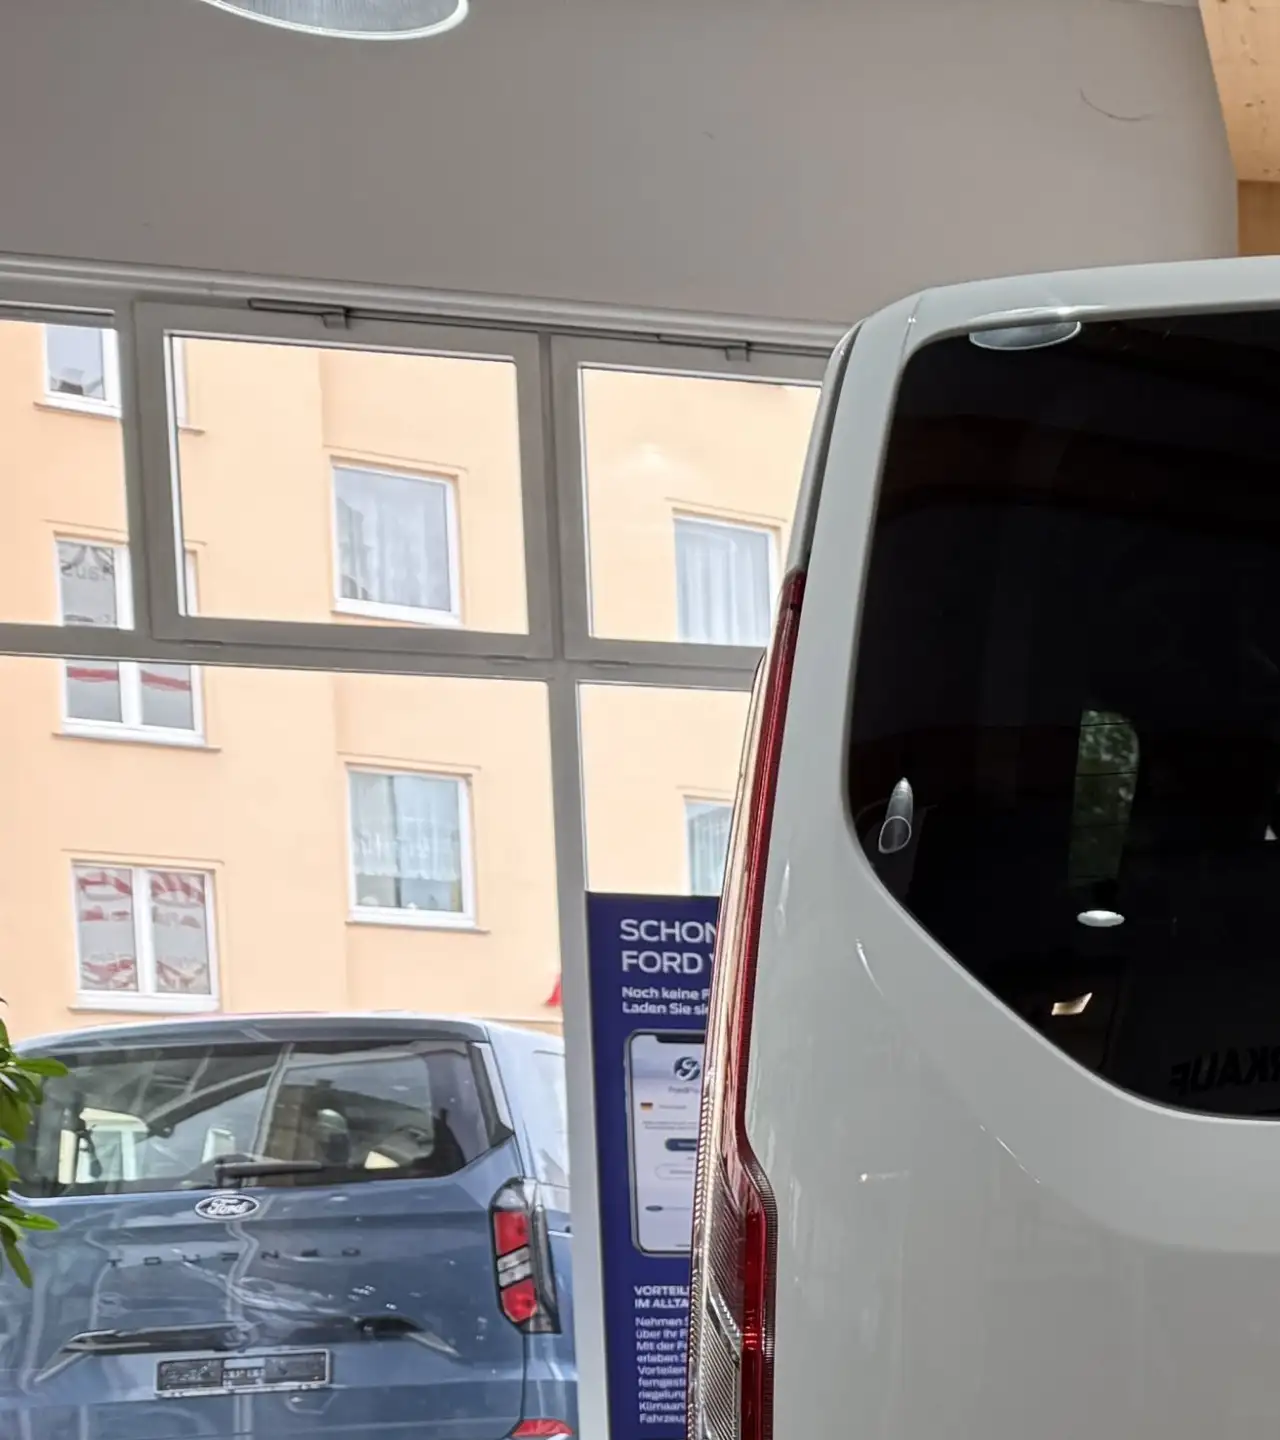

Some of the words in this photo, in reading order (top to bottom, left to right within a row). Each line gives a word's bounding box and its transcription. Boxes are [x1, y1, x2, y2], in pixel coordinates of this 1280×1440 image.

[621, 950, 704, 975] FORD
[622, 986, 660, 999] Noch
[661, 987, 700, 1000] keine
[622, 1001, 667, 1014] Laden
[669, 1002, 692, 1015] Sie
[634, 1285, 690, 1297] VORTEIL
[634, 1298, 650, 1309] IM
[652, 1298, 689, 1309] ALLTA
[635, 1317, 683, 1327] Nehmen
[636, 1329, 661, 1339] über
[663, 1329, 677, 1339] Ihr
[636, 1341, 654, 1351] Mit
[655, 1341, 675, 1351] der
[636, 1353, 679, 1363] erleben
